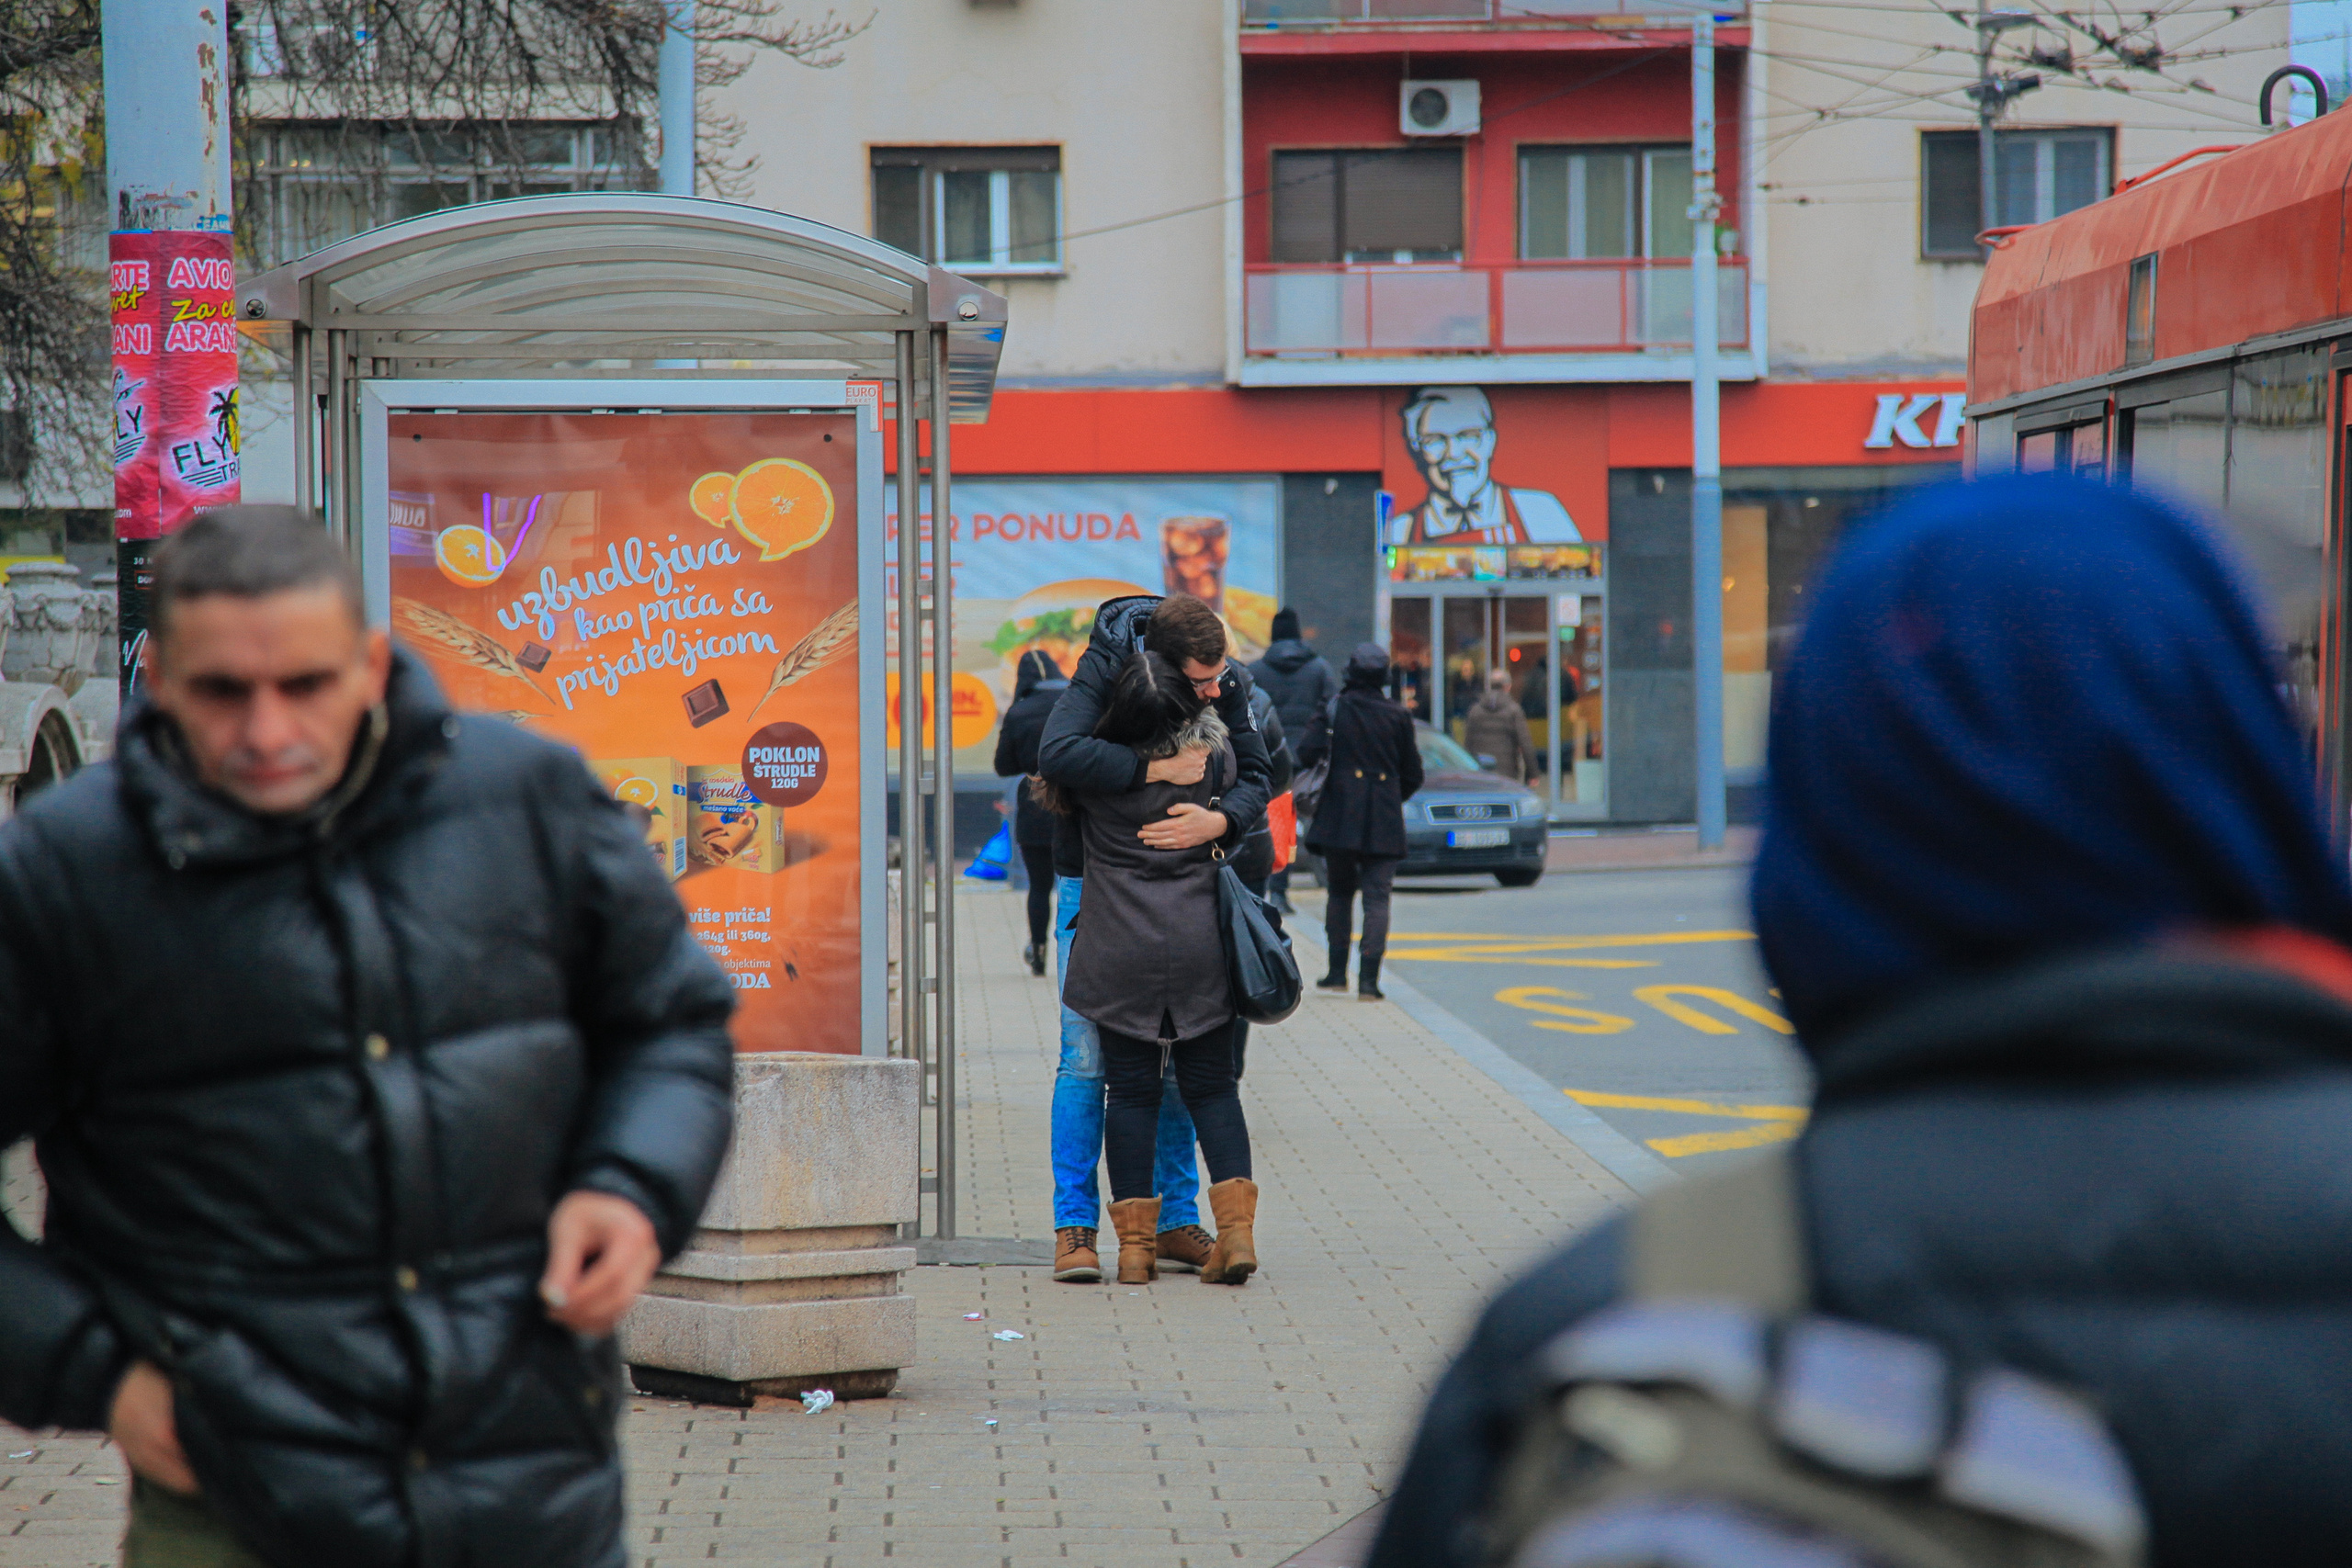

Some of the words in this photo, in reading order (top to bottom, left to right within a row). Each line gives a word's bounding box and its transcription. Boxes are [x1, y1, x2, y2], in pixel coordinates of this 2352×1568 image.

[167, 256, 232, 290] AVIO
[171, 299, 217, 322] Za
[846, 387, 876, 397] EURO
[1864, 393, 1967, 448] KF
[172, 432, 229, 473] FLY
[972, 512, 1142, 542] PONUDA
[497, 534, 741, 641] uzbudljiva
[574, 607, 634, 641] kao
[639, 584, 724, 639] priča
[556, 629, 779, 710] prijateljicom
[749, 747, 820, 763] POKLON
[753, 761, 817, 778] ŠTRUDLE
[771, 778, 799, 789] 120G
[688, 907, 721, 923] više
[724, 907, 772, 927] priča!
[696, 931, 725, 943] 264g
[726, 930, 738, 940] ili
[741, 931, 771, 943] 360g,
[724, 958, 771, 971] objektima
